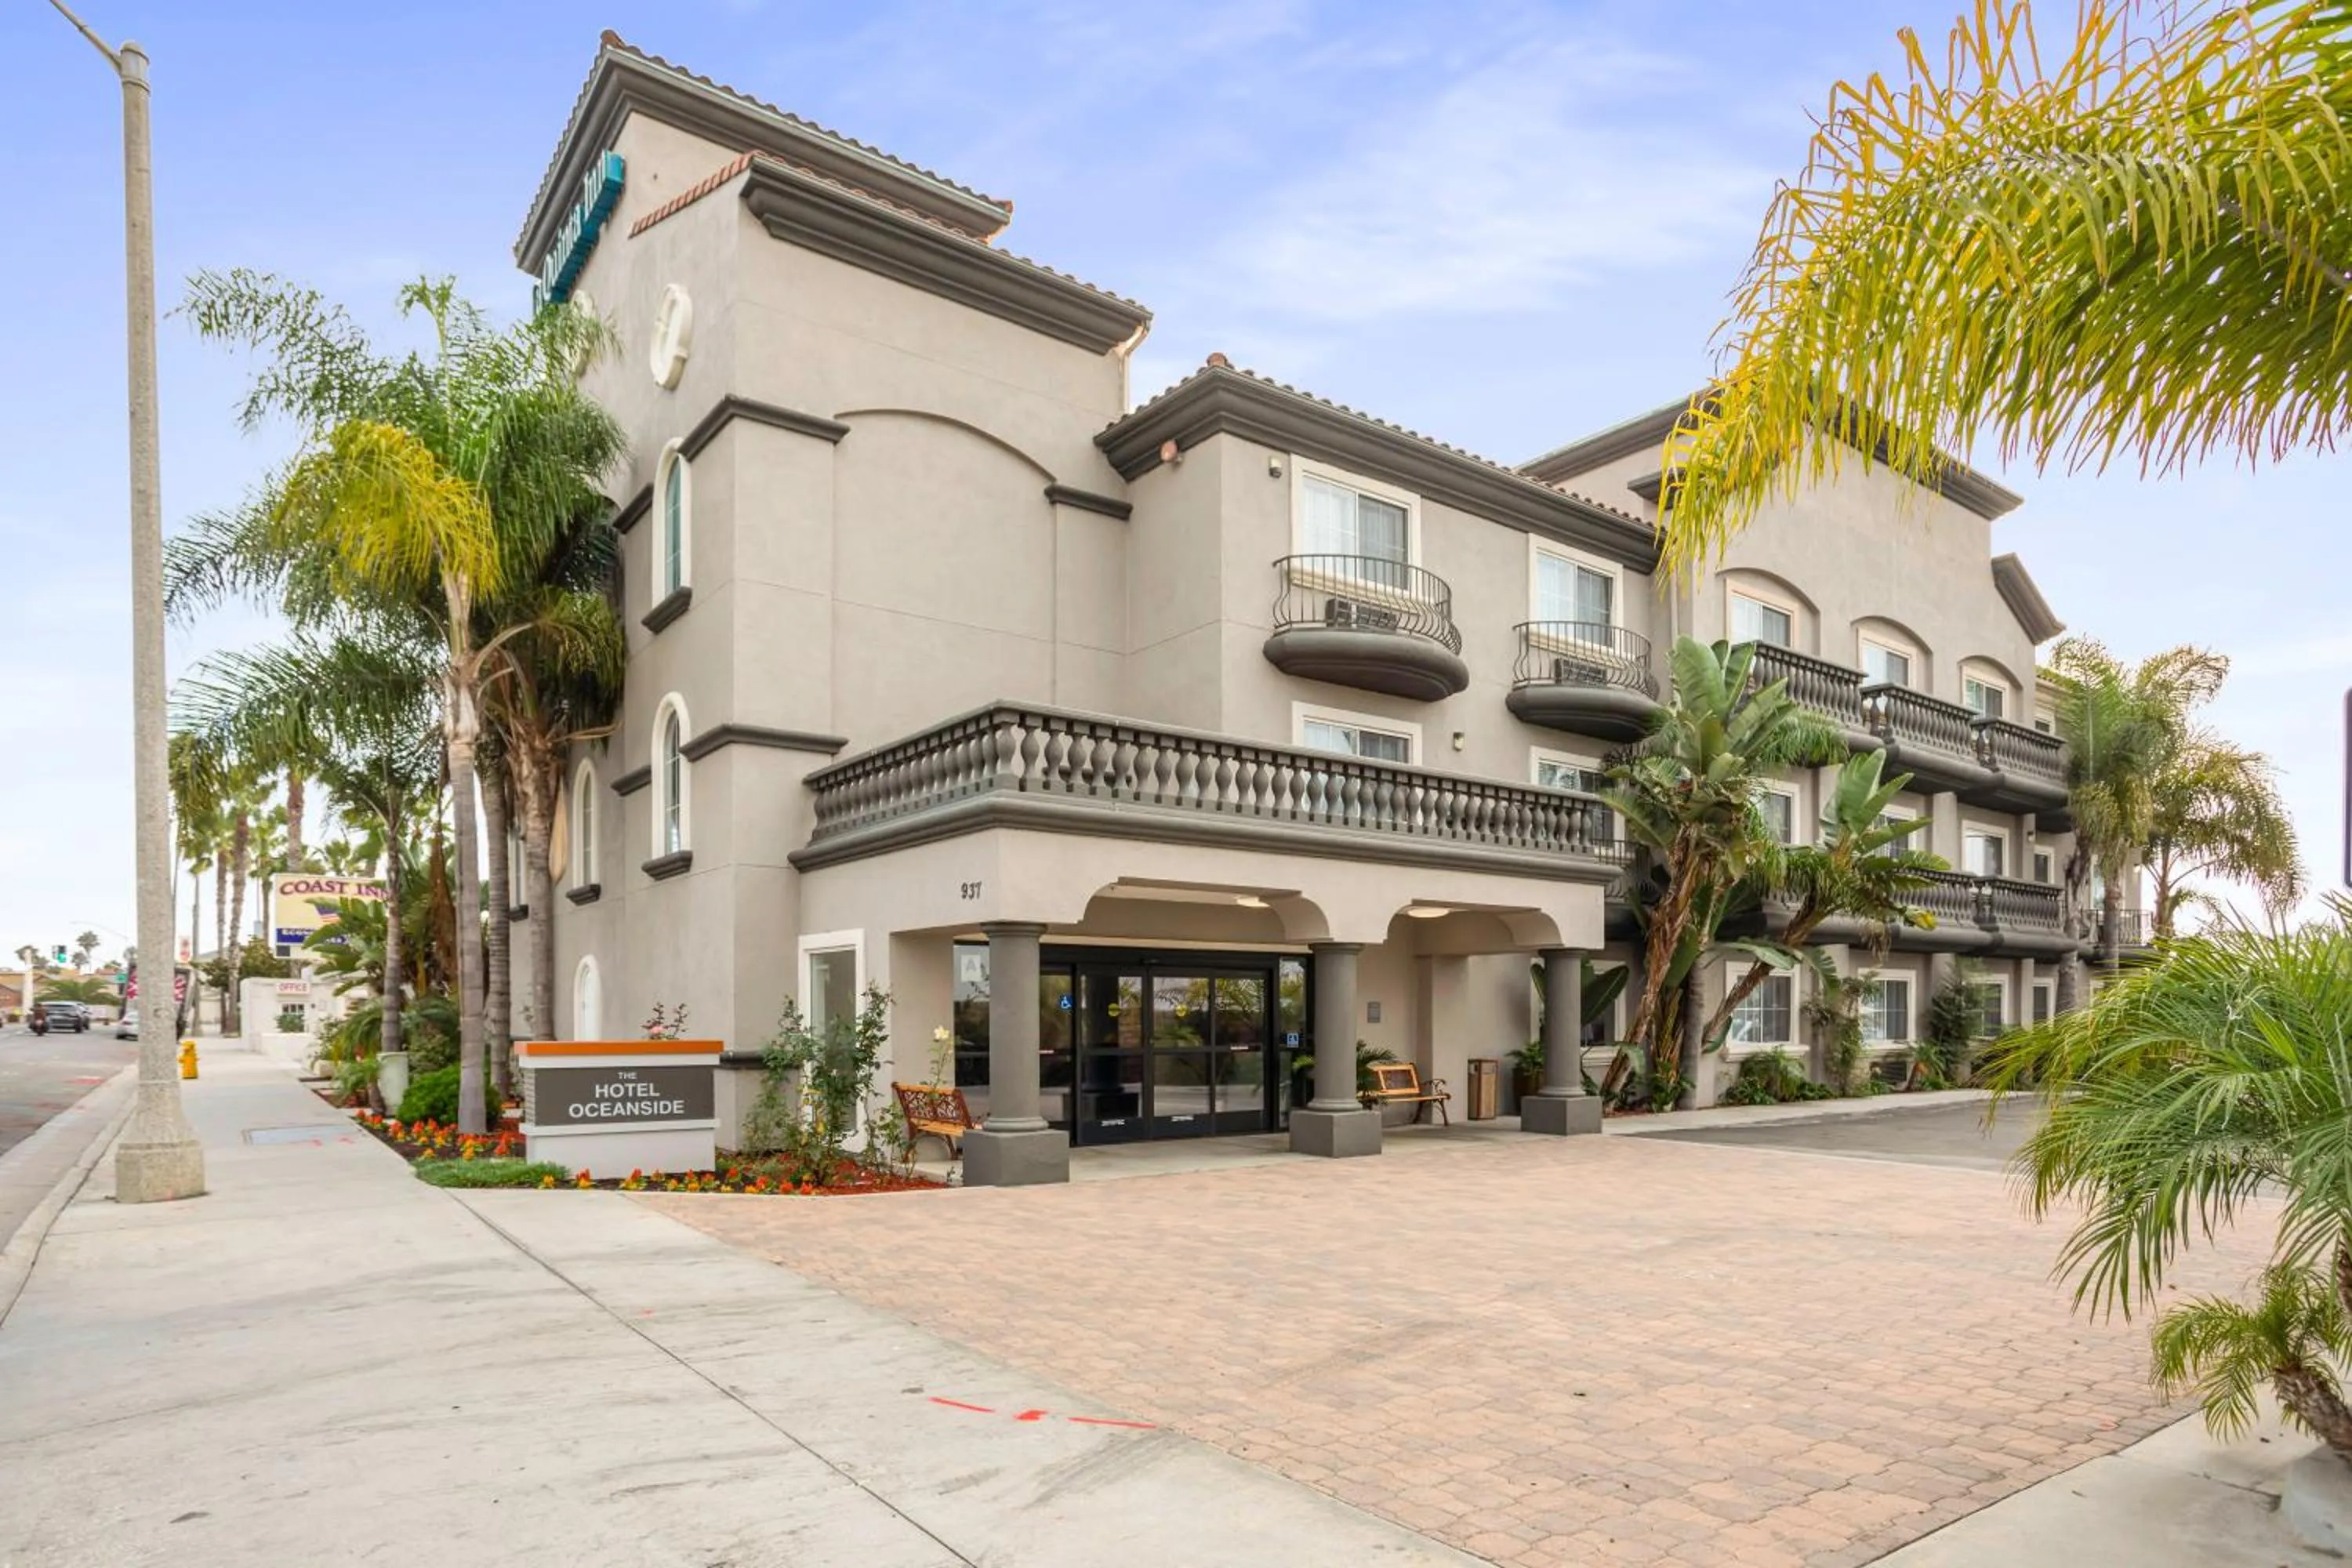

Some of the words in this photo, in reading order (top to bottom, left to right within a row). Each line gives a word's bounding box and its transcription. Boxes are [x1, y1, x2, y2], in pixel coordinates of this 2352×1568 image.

[279, 880, 350, 895] COAST
[960, 881, 982, 899] 937
[965, 957, 978, 971] A
[278, 982, 308, 992] OFFICE
[595, 1083, 660, 1098] HOTEL
[568, 1100, 685, 1119] OCEANSIDE
